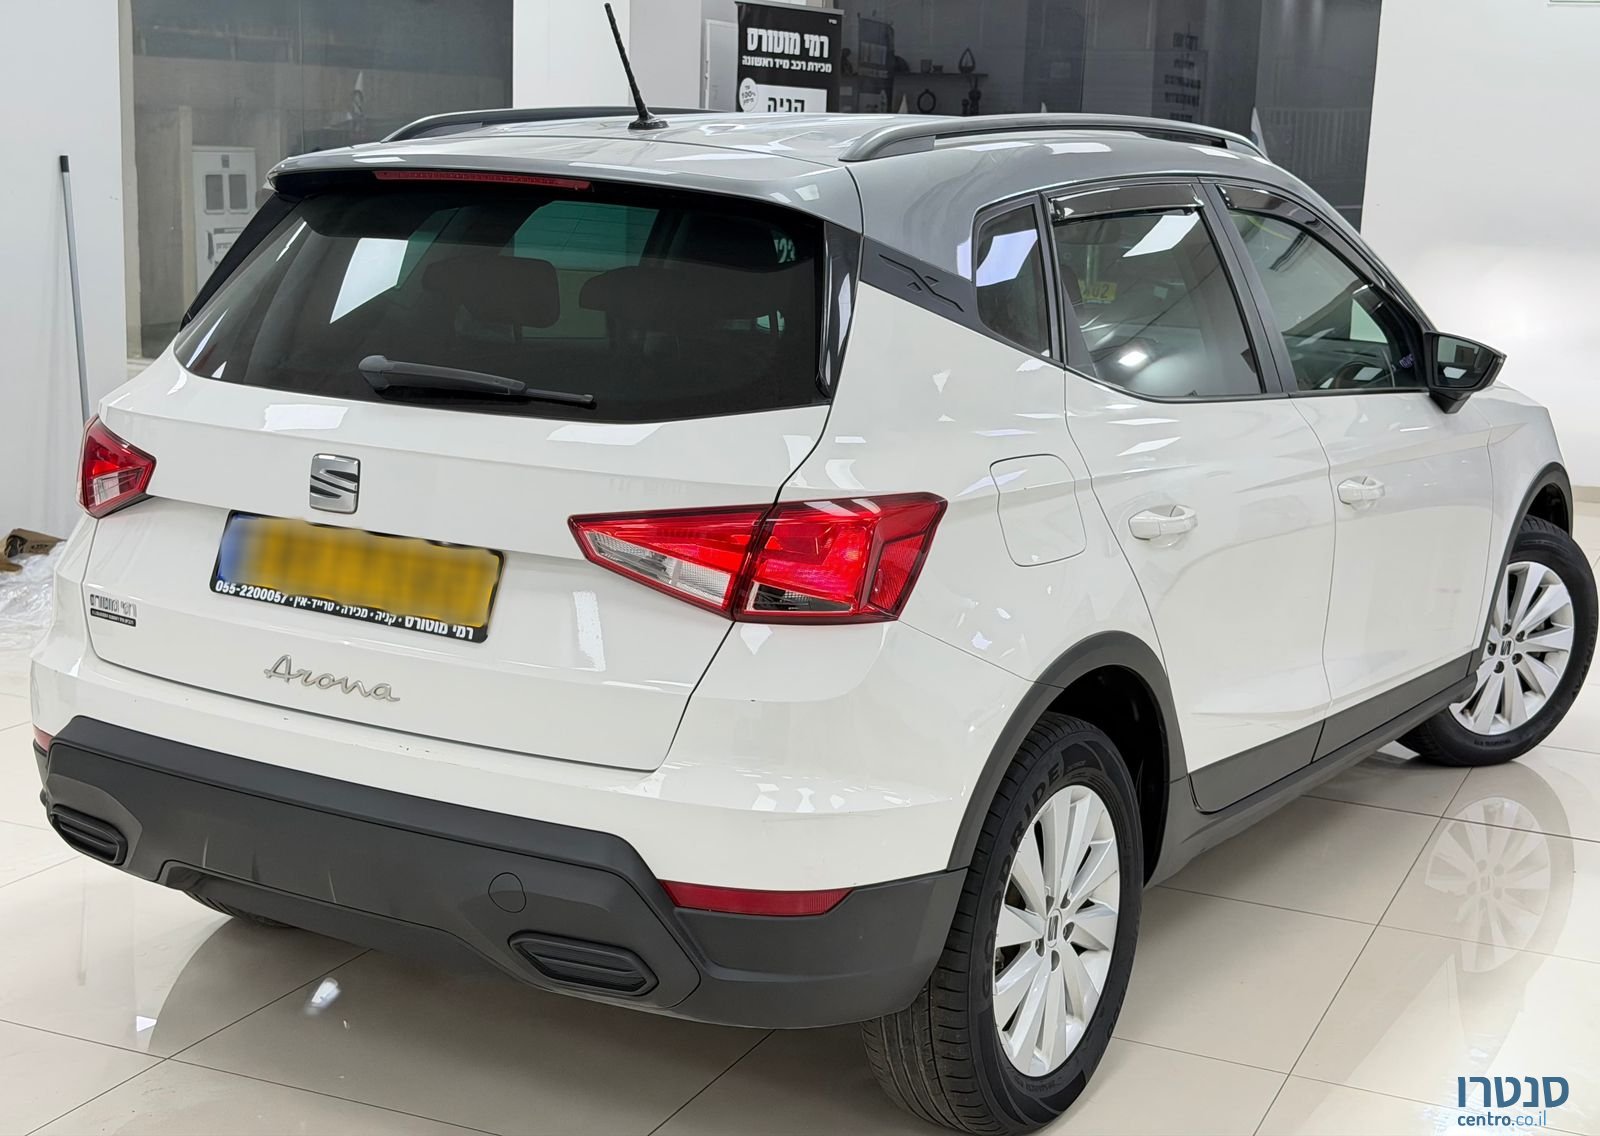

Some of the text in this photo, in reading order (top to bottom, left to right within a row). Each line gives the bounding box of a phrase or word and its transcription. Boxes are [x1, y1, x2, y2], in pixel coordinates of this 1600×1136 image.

[747, 27, 830, 58] רמי מוטורס
[742, 55, 832, 73] מכירת רכב מיד ראשונה
[215, 579, 474, 640] רמי מוטורס קניה מכירה טרייד-אין 055-2200057
[263, 654, 400, 703] Arona
